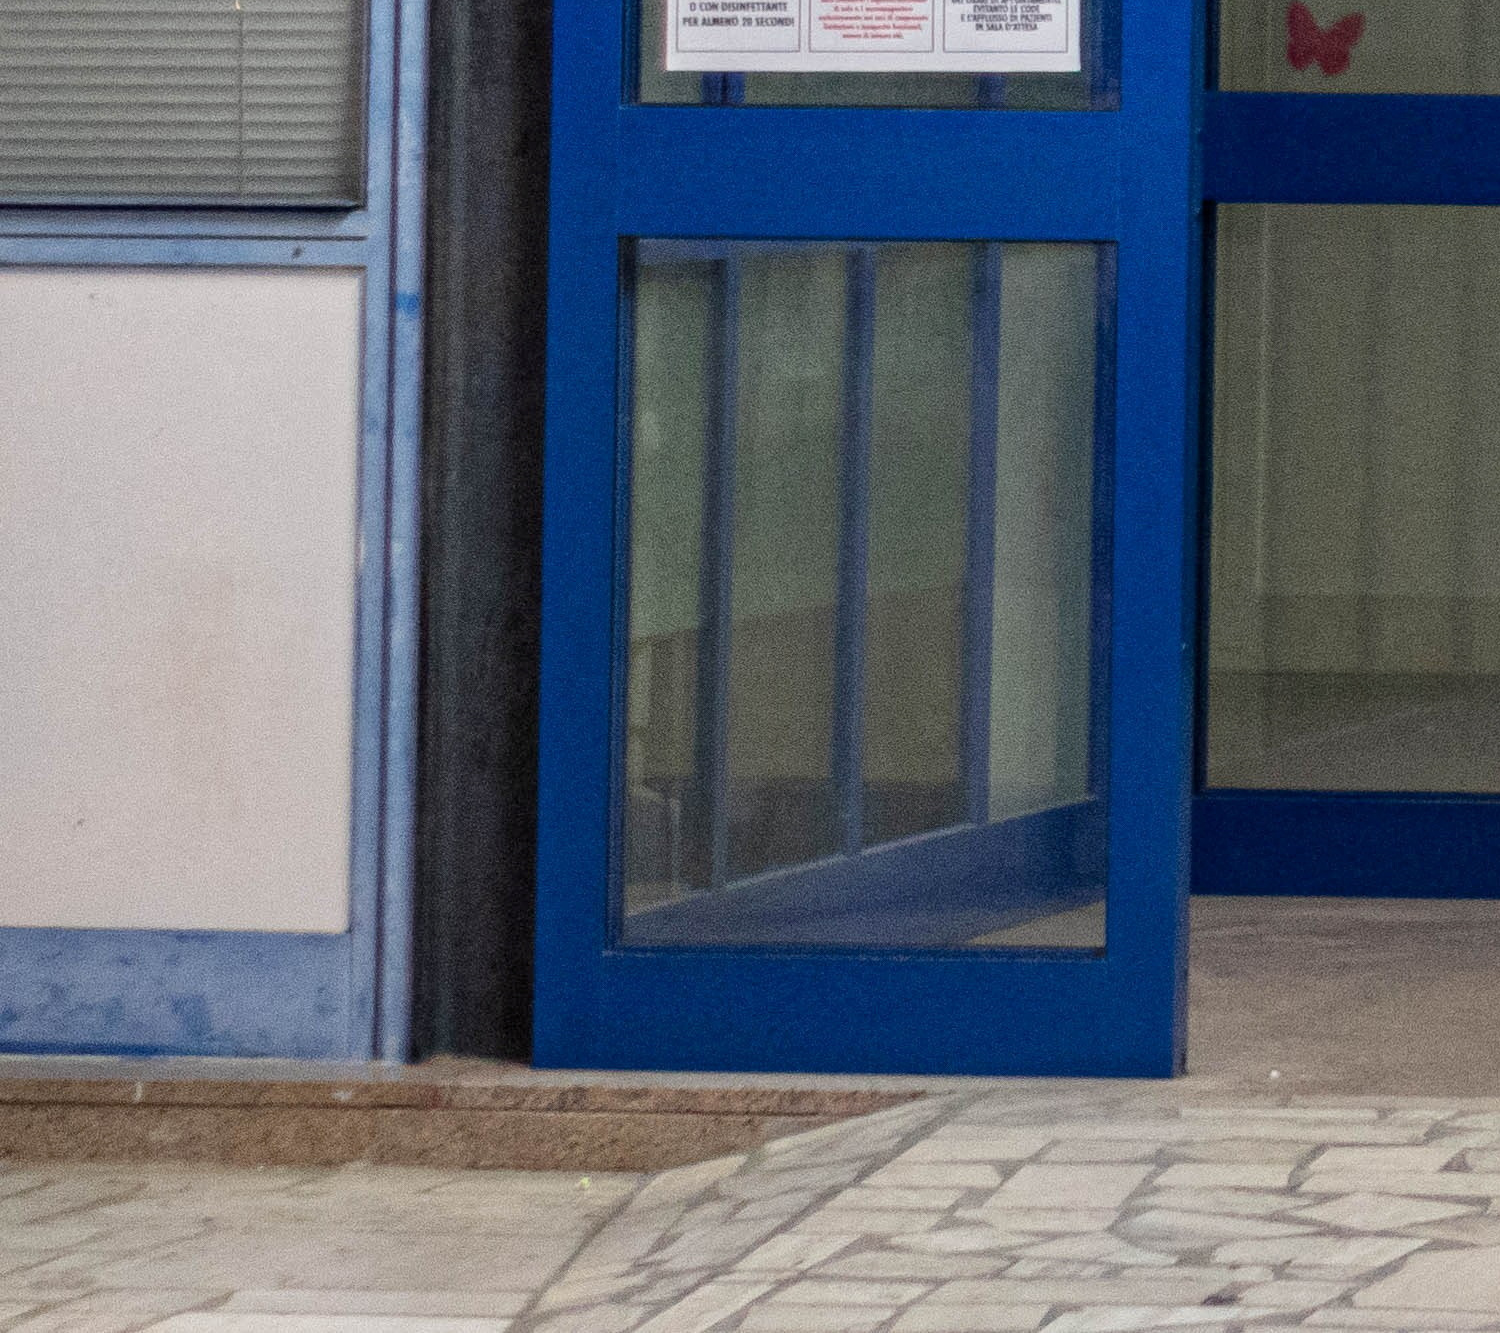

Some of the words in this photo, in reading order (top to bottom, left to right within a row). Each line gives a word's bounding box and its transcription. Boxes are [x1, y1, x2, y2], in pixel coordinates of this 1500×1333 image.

[699, 1, 719, 12] CON
[721, 1, 788, 12] DISINFETTANTE
[682, 17, 699, 27] PER
[701, 17, 739, 27] ALMENO
[755, 17, 794, 27] SECONDI
